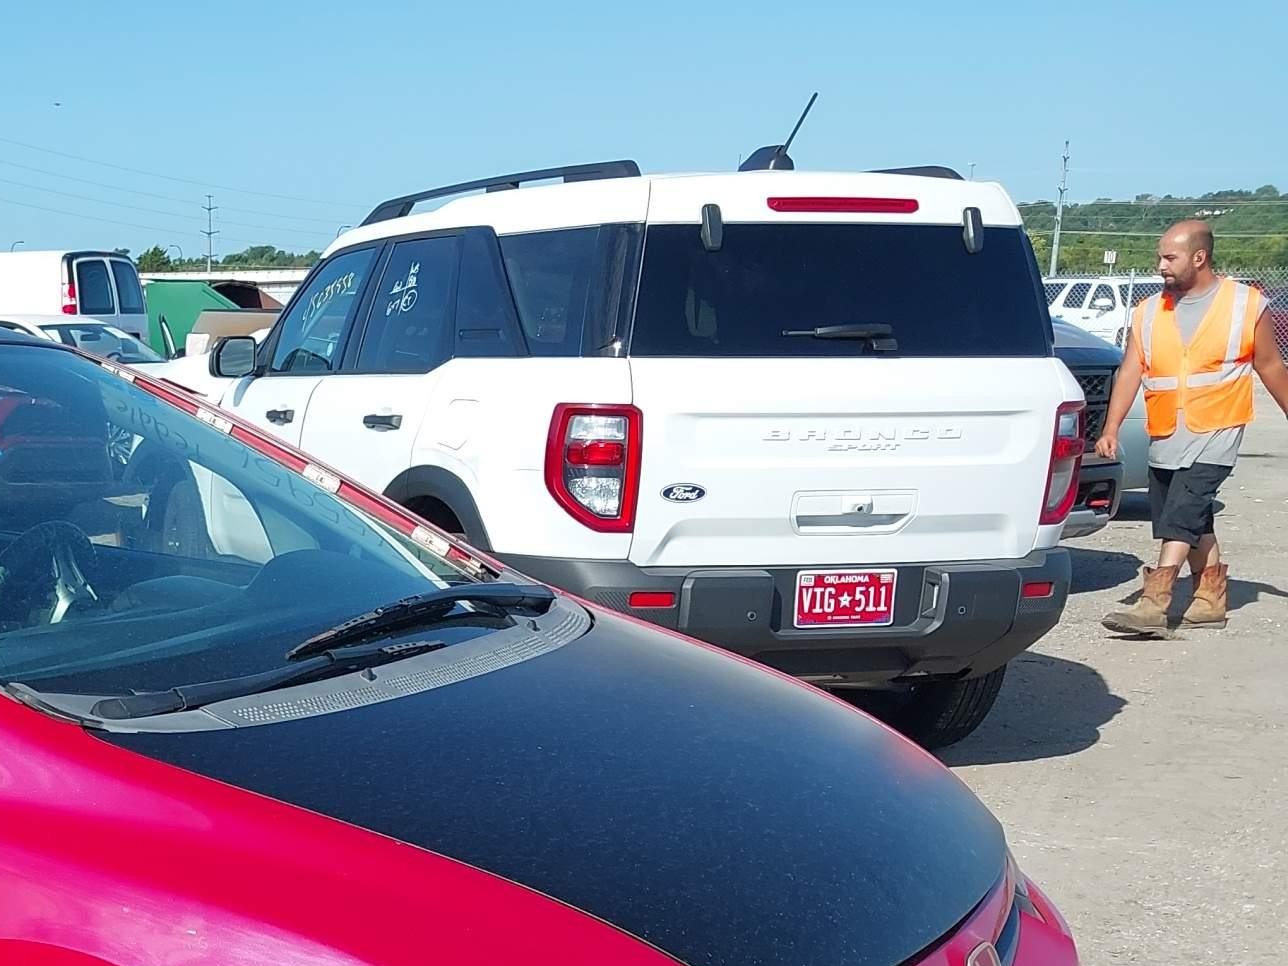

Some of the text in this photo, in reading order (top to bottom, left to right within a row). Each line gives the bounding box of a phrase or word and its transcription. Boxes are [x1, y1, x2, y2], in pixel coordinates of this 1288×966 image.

[761, 424, 965, 442] BRONCO
[826, 442, 902, 453] SPORT
[669, 486, 700, 500] Ford
[823, 575, 870, 584] OKLAHOMA
